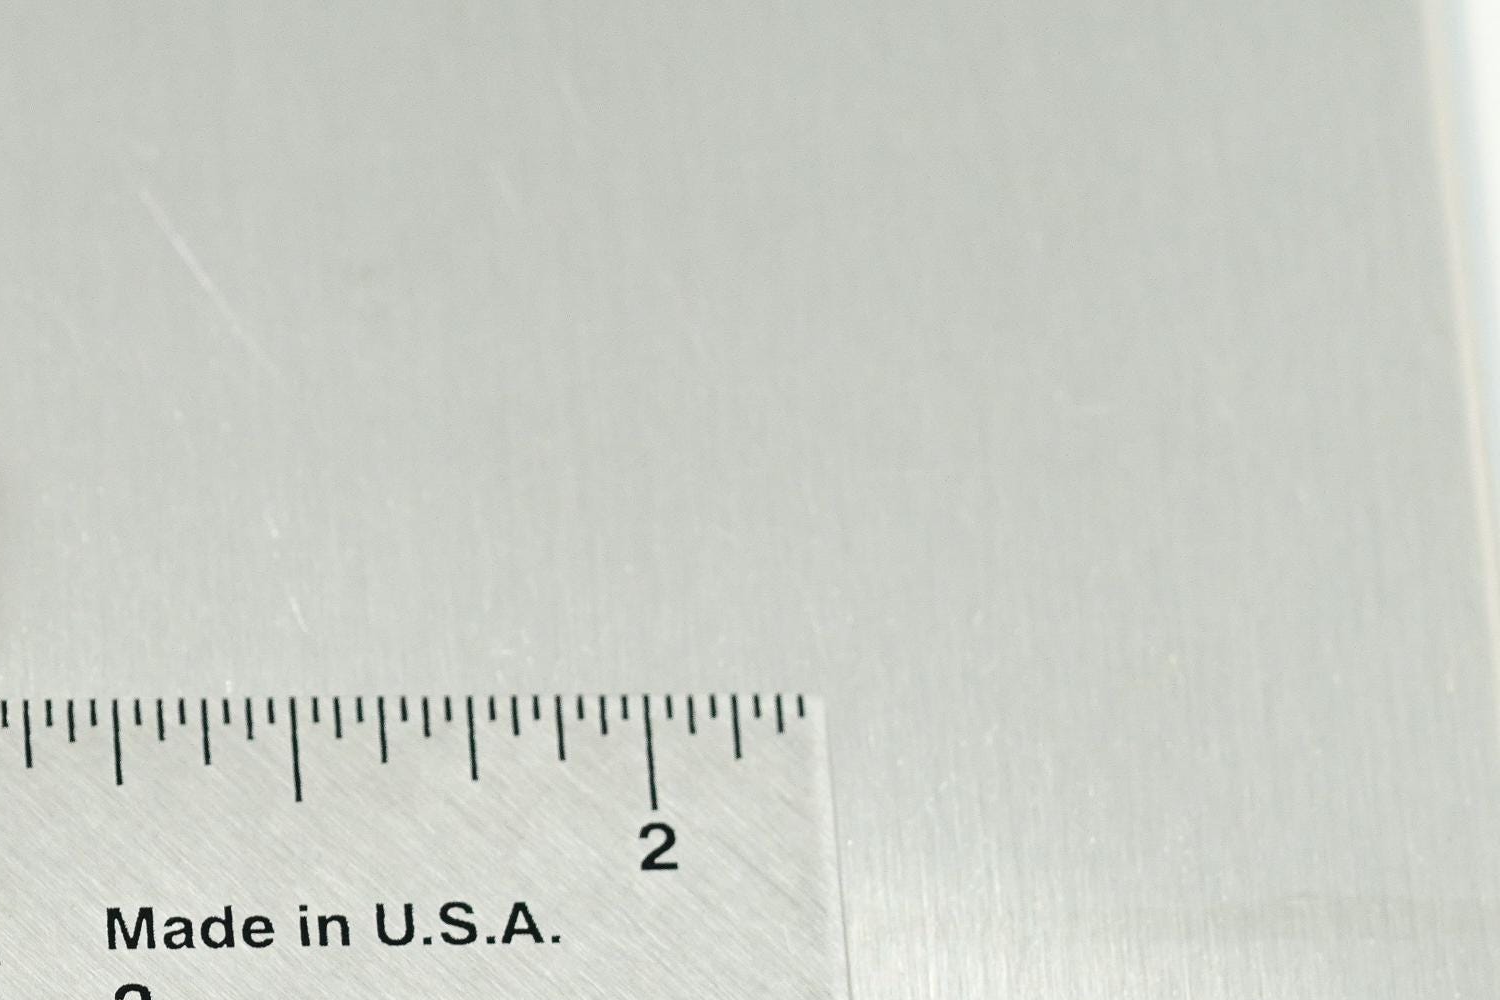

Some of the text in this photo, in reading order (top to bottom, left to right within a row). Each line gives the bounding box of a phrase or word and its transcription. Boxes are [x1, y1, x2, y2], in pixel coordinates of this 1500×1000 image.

[639, 822, 679, 871] 2
[106, 901, 563, 950] Made in U.S.A.
